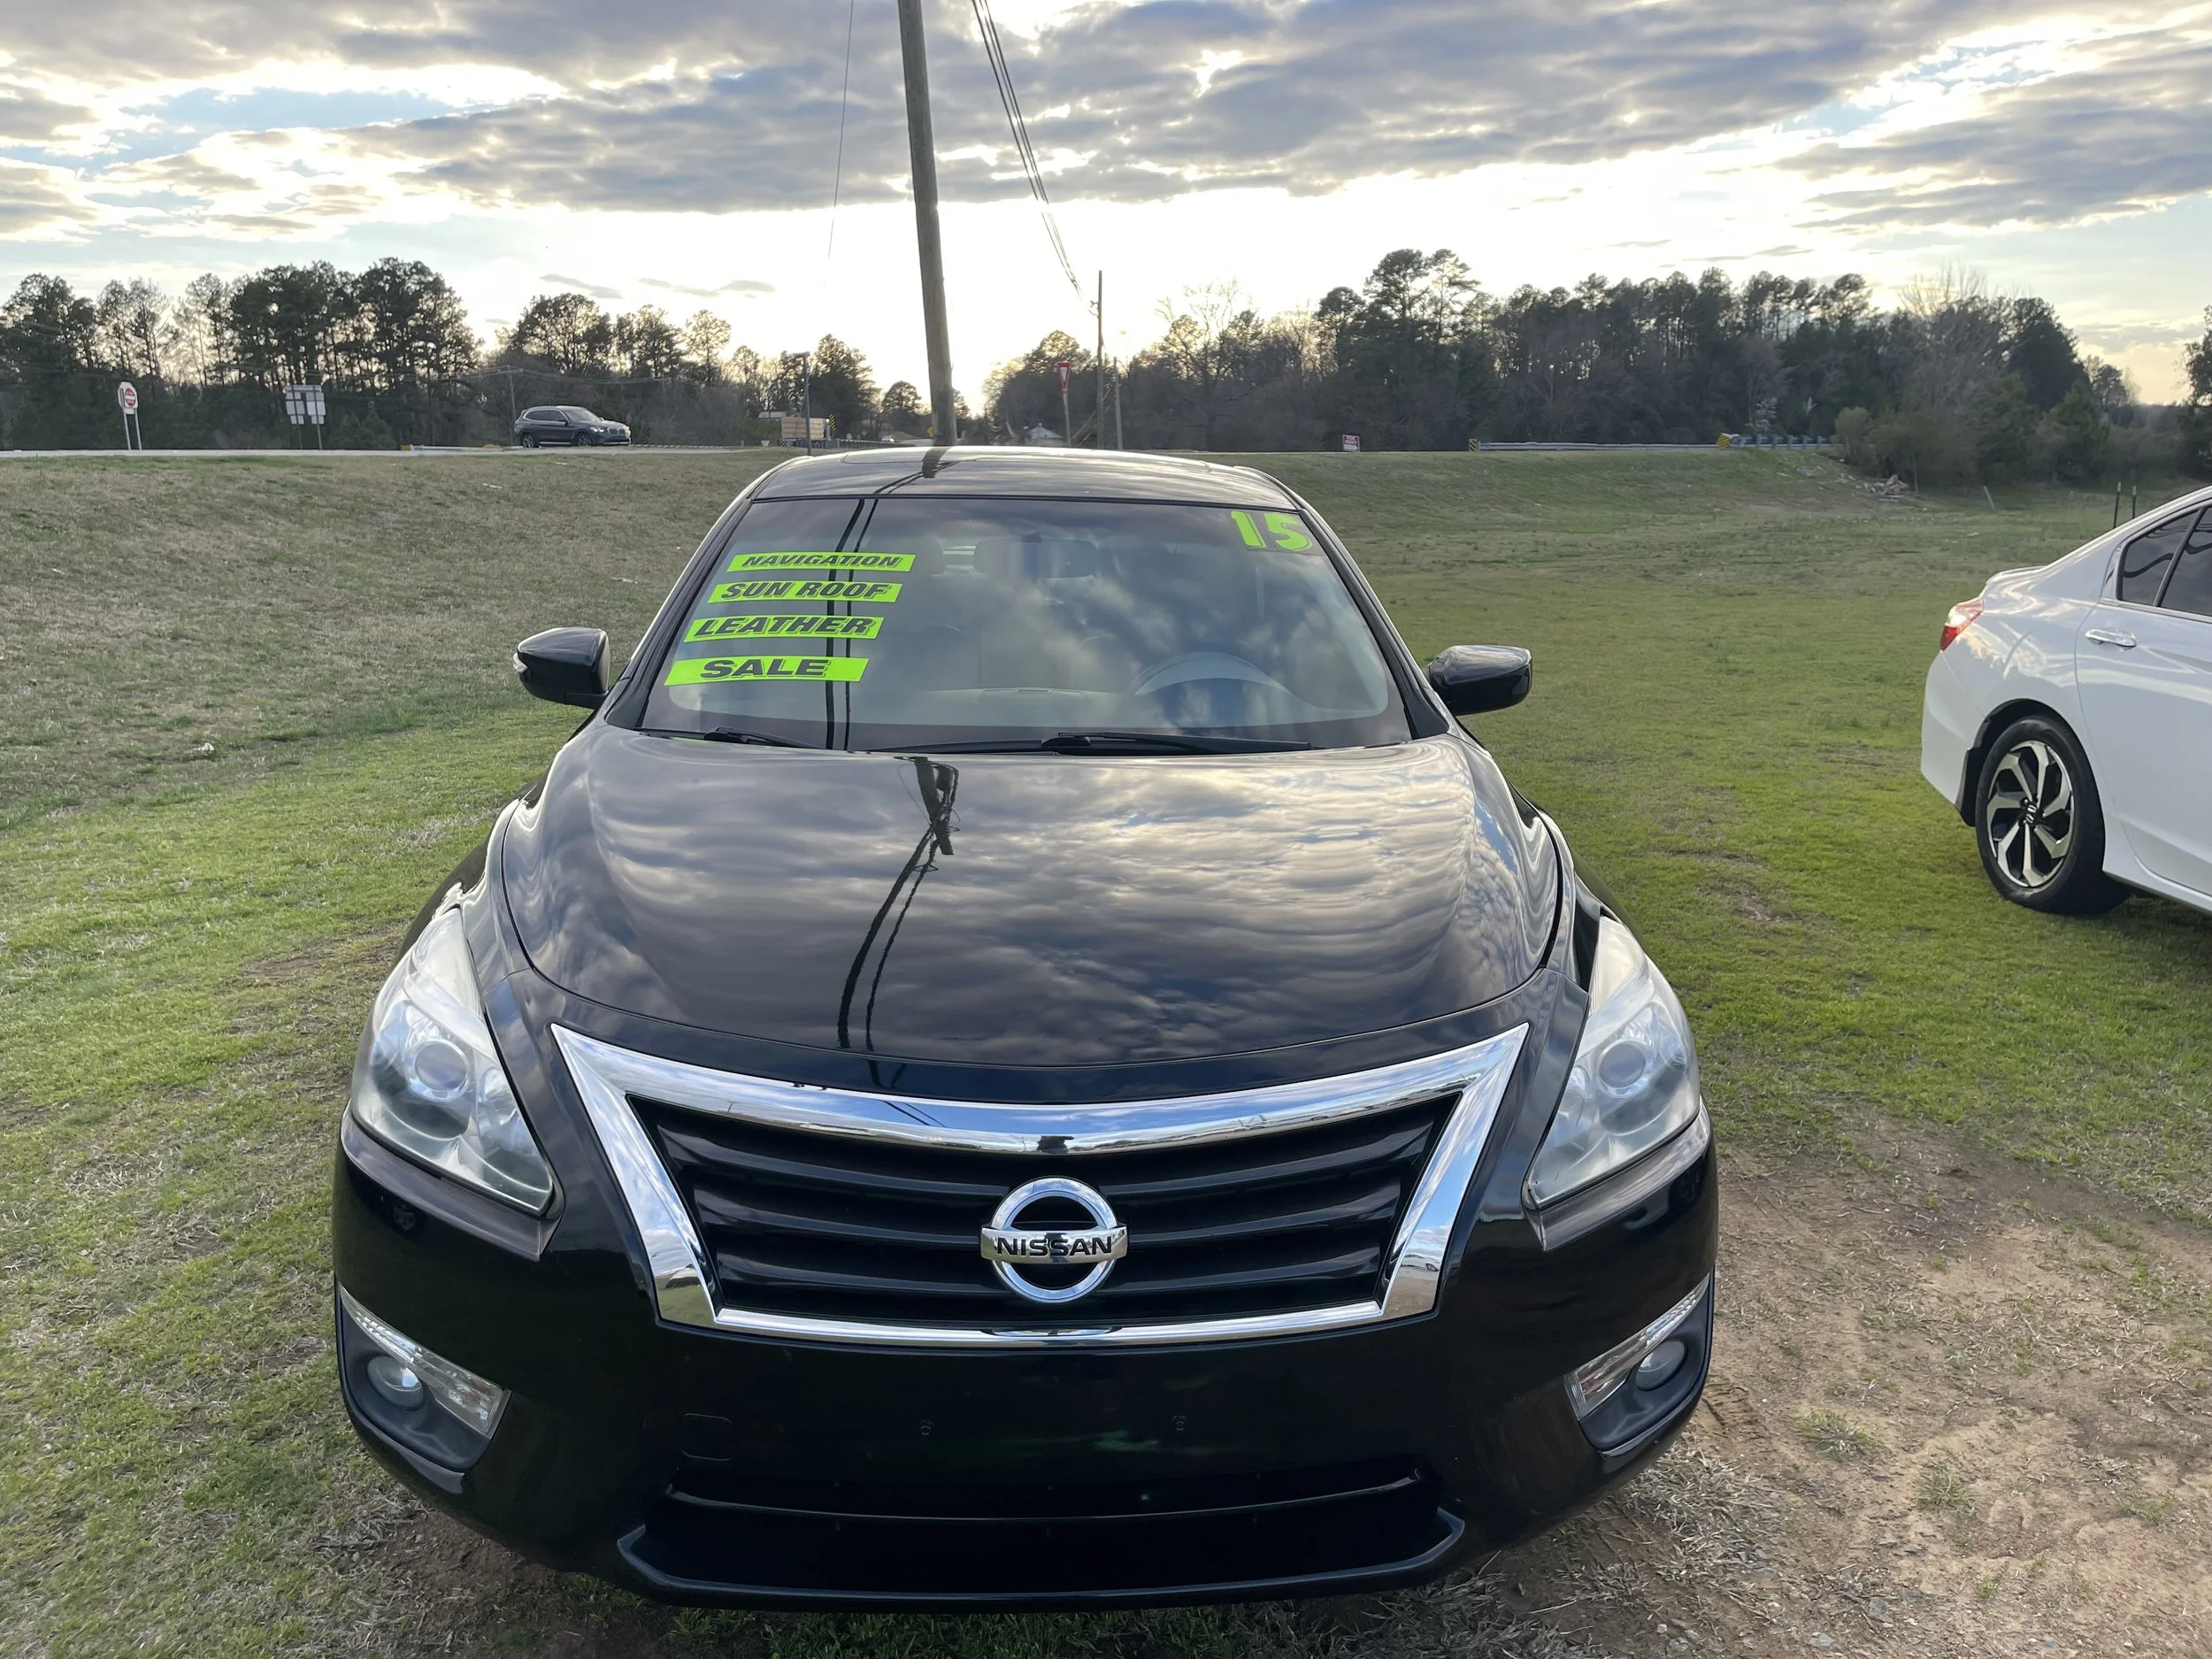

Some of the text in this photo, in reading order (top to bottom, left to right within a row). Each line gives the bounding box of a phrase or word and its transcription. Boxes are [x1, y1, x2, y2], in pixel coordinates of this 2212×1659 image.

[1231, 511, 1313, 552] 15
[741, 554, 904, 569] NAVIGATION
[721, 580, 890, 599] SUN ROOF
[694, 616, 876, 638] LEATHER
[700, 657, 832, 680] SALE
[997, 1235, 1112, 1256] NISSAN
